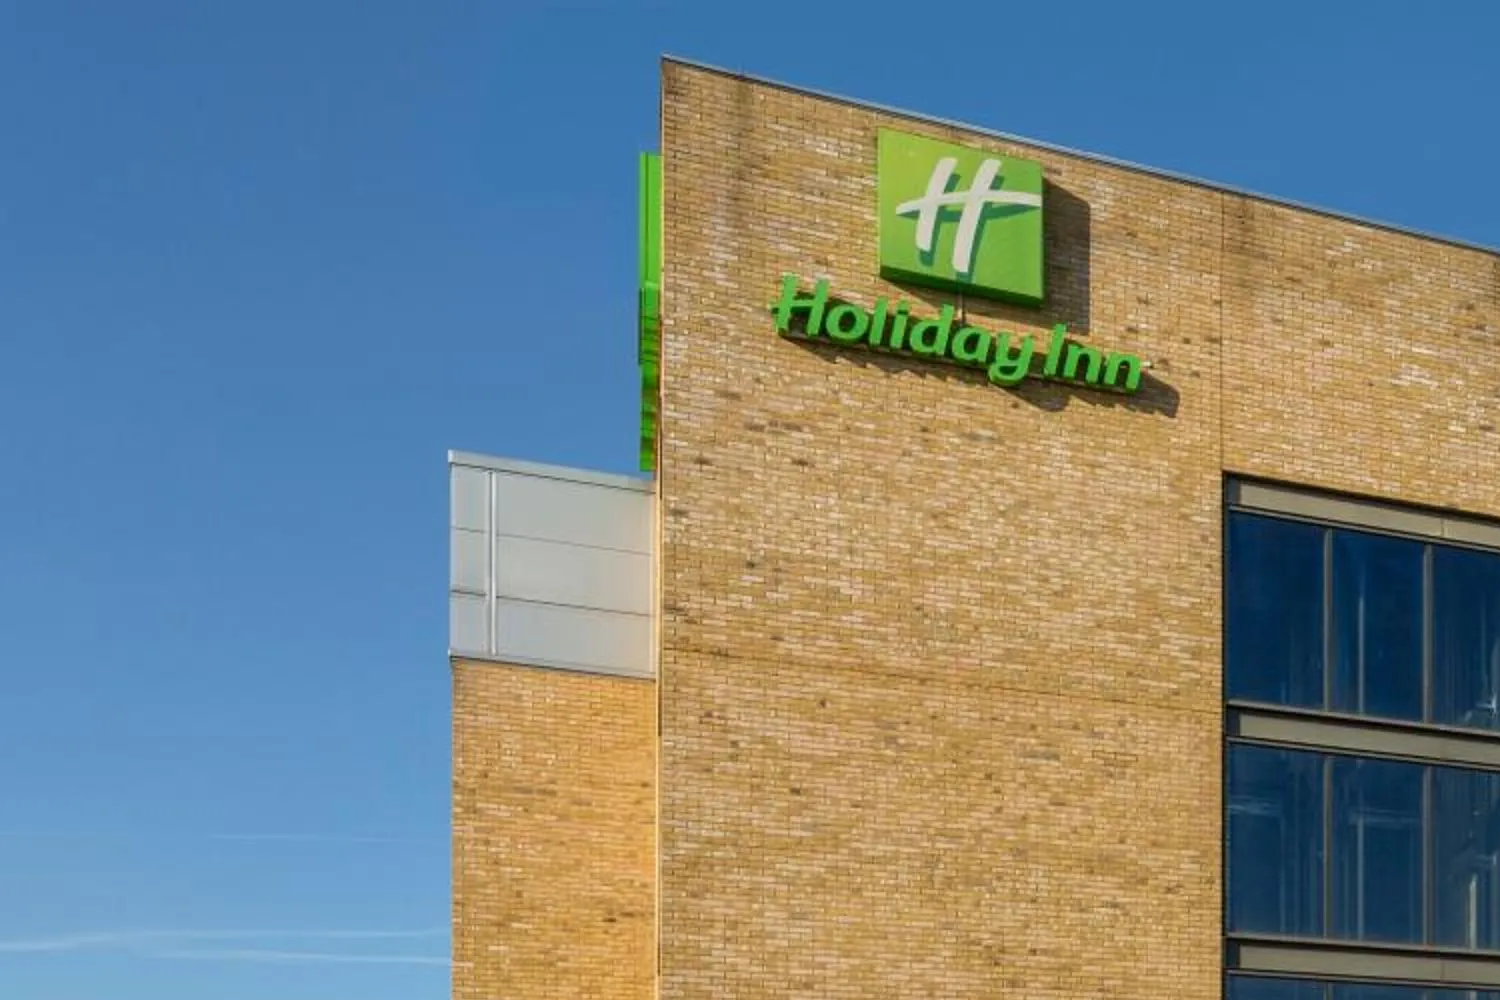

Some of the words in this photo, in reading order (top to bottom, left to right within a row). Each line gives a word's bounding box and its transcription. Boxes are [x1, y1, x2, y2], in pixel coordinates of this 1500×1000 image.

[896, 158, 1042, 272] H
[771, 273, 1034, 386] Holiday
[1043, 323, 1143, 393] Inn
